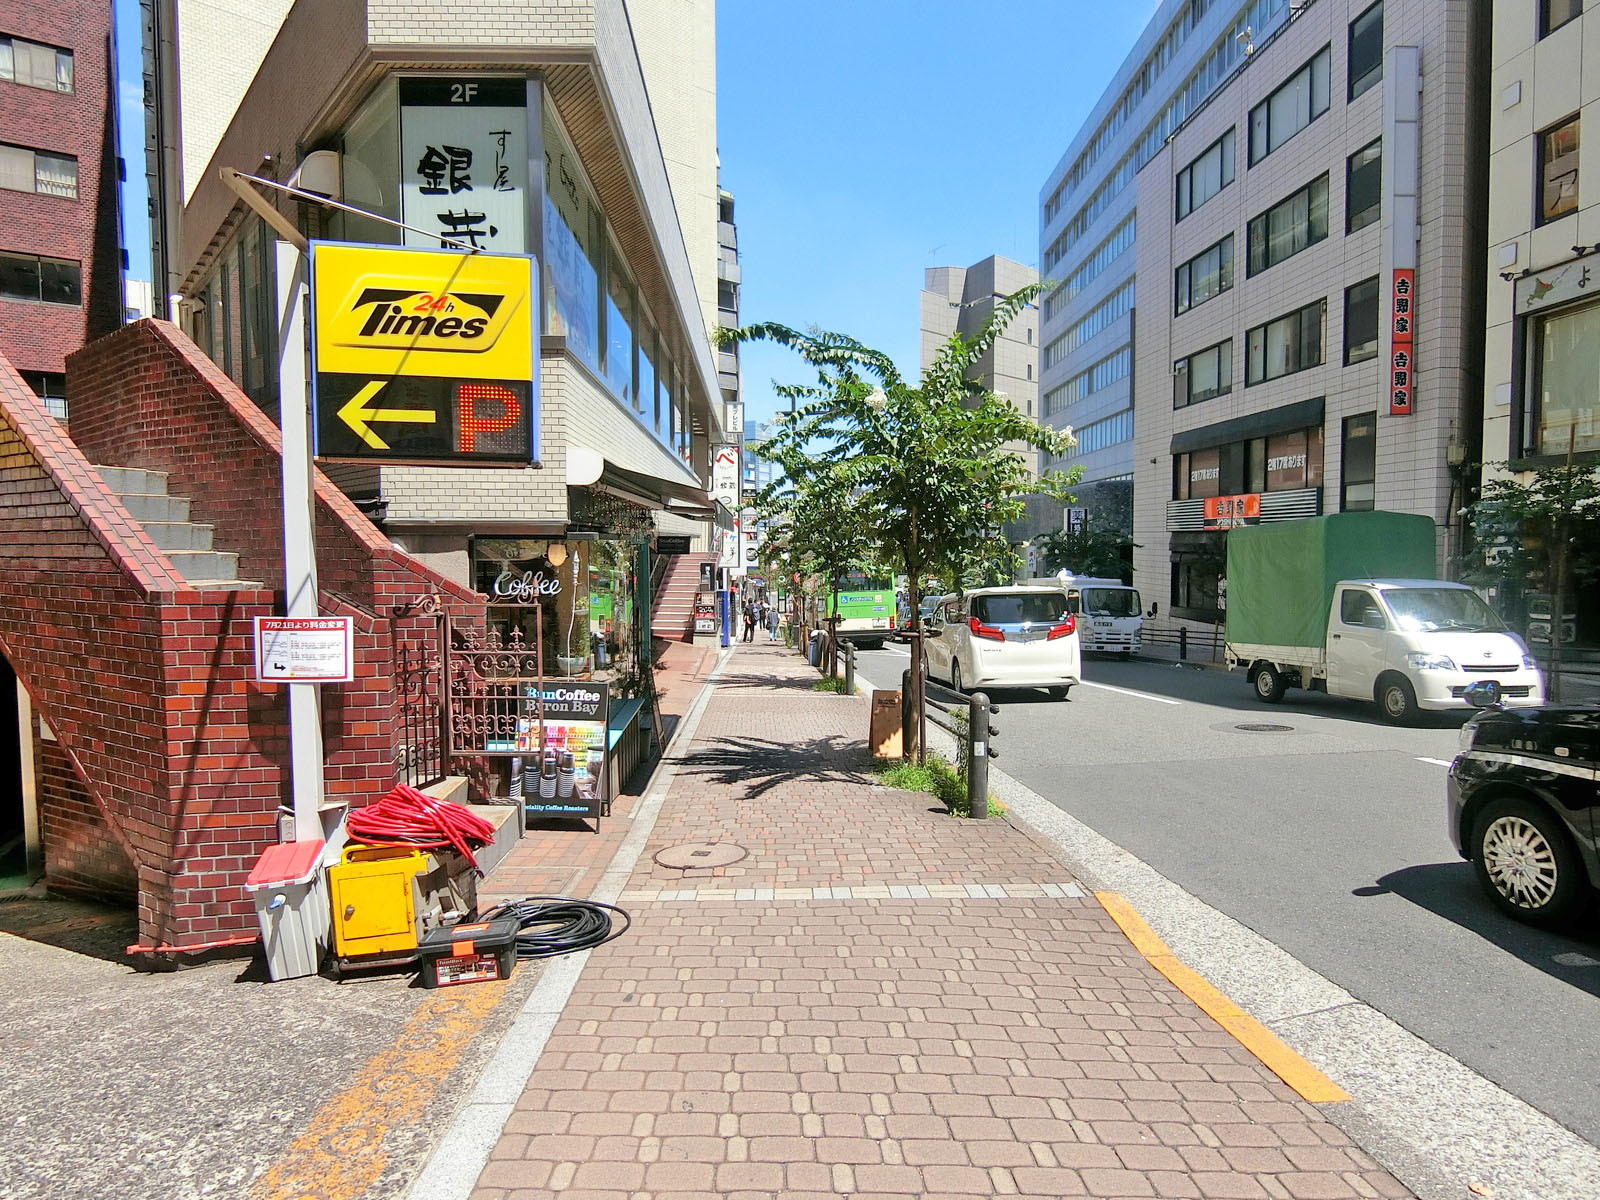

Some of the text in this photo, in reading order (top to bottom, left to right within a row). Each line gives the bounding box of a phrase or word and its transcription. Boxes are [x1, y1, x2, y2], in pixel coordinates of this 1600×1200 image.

[450, 83, 479, 103] 2F
[417, 145, 499, 250] 銀蔵
[352, 289, 500, 339] Times
[413, 294, 455, 313] 24h
[1395, 278, 1410, 333] 吉野家
[1393, 352, 1408, 406] 吉野家
[459, 384, 521, 453] P
[494, 571, 562, 596] Coffee
[524, 699, 599, 716] Byron Bay
